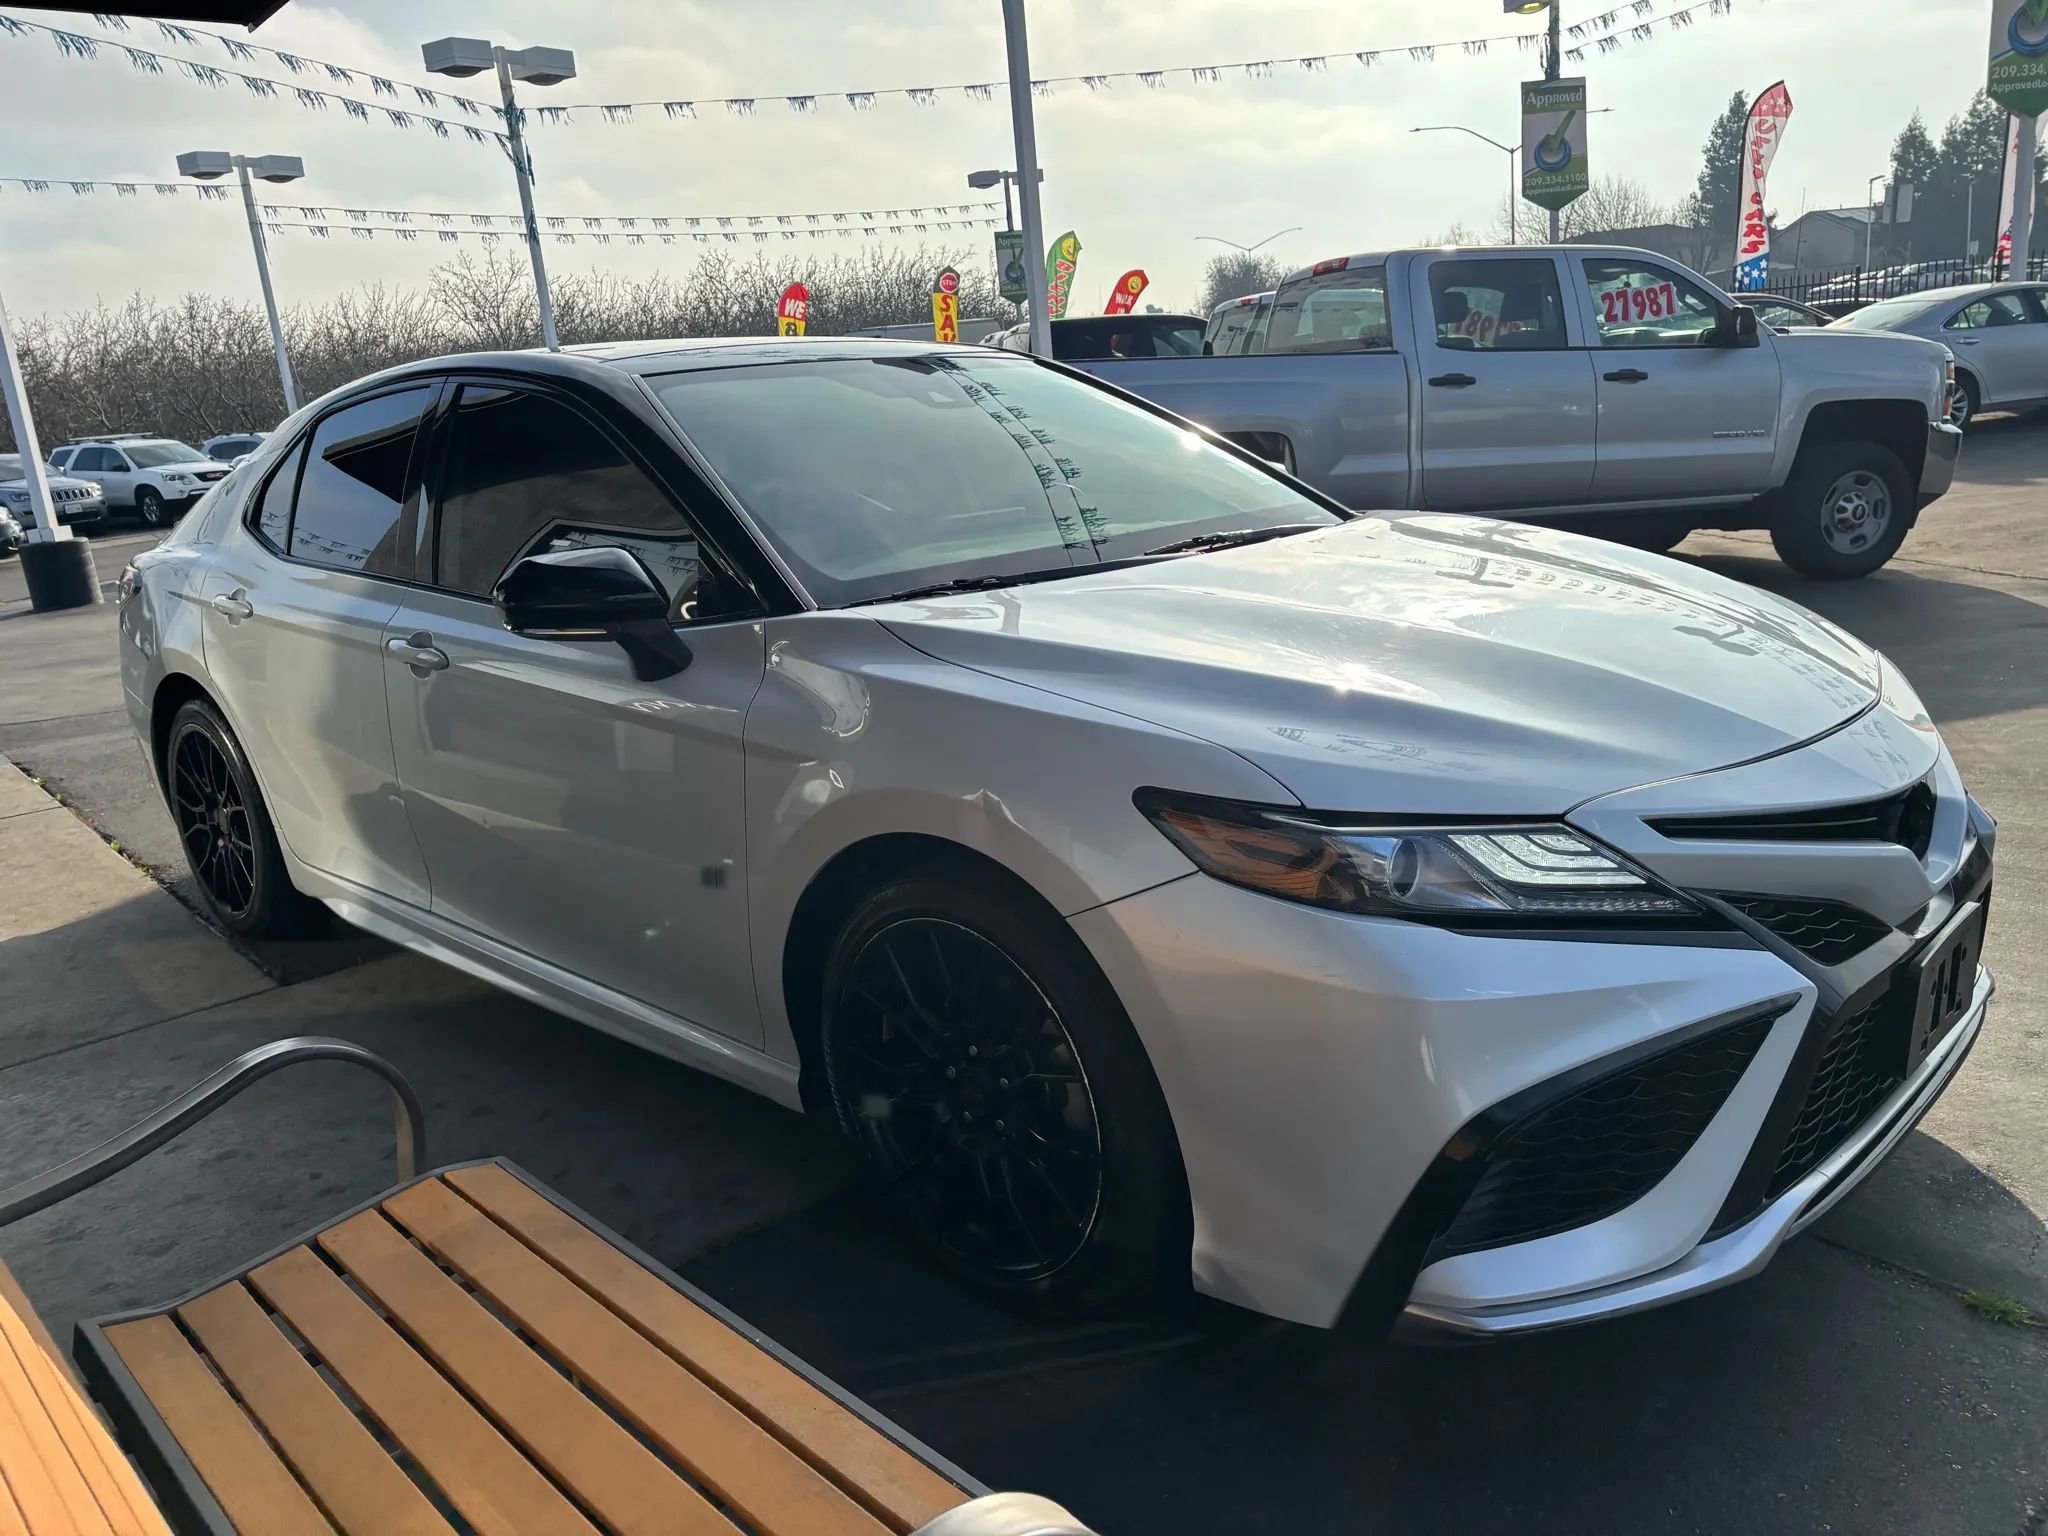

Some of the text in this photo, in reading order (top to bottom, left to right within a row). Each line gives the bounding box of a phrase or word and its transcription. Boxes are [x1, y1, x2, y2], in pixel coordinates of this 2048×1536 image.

[1991, 79, 2048, 94] ApprovedLo
[1526, 87, 1583, 108] Approved
[1524, 172, 1586, 187] 209.334.1100
[784, 298, 806, 319] WE
[1601, 282, 1674, 323] 27987
